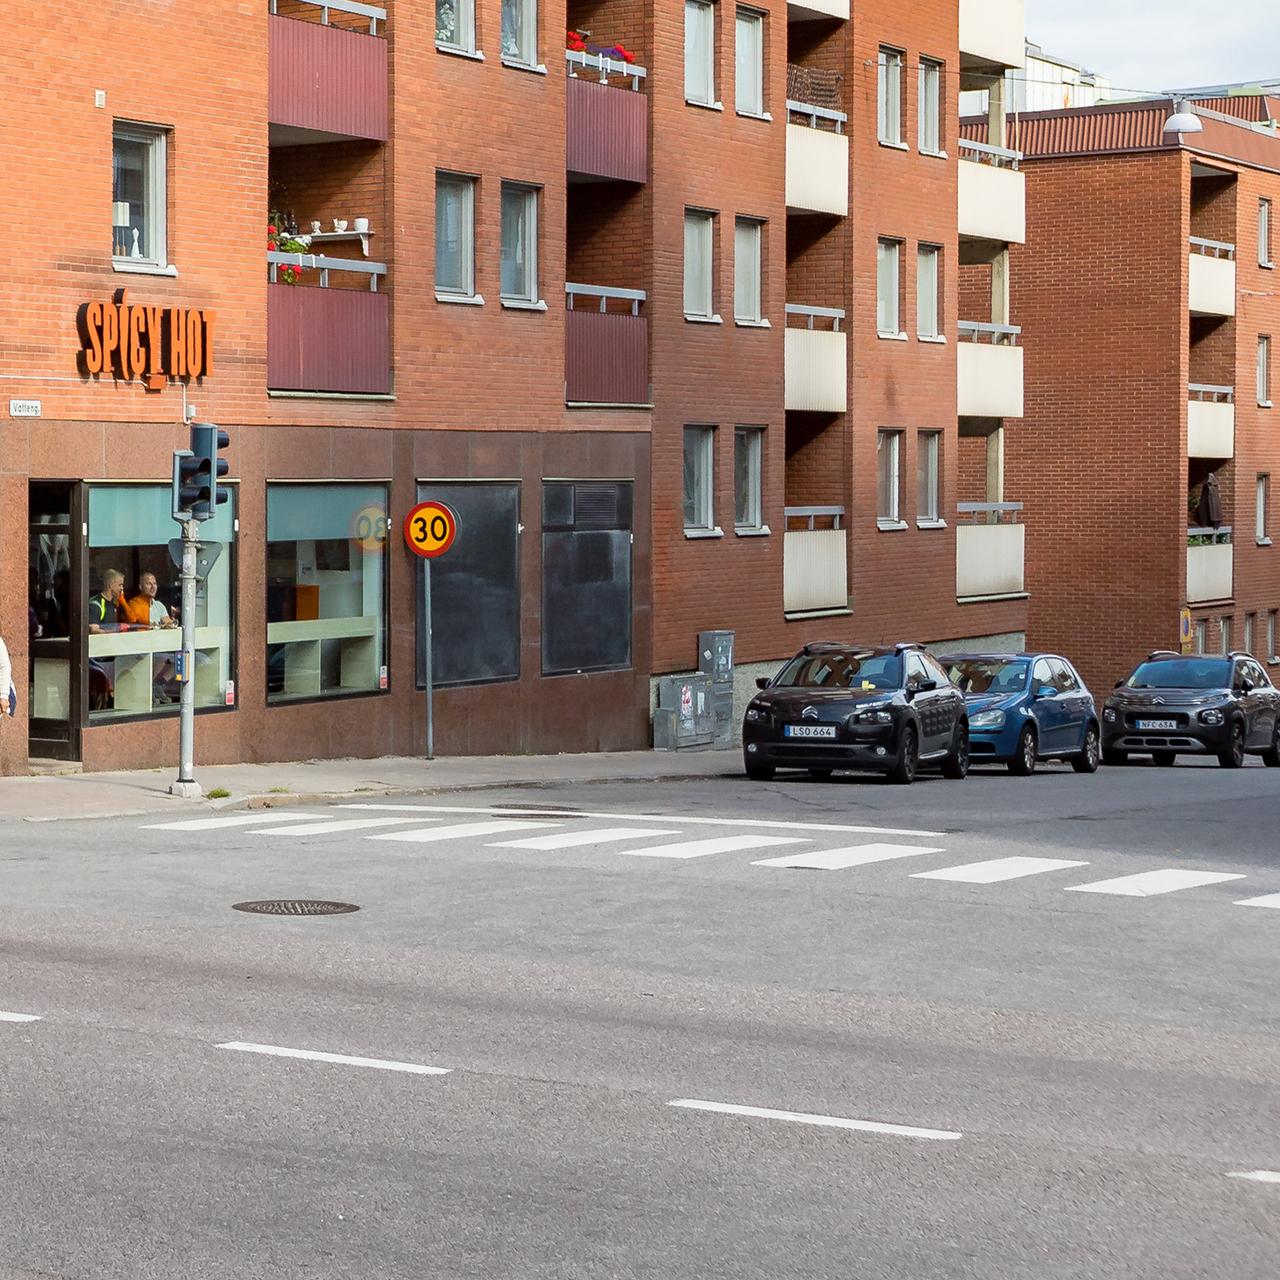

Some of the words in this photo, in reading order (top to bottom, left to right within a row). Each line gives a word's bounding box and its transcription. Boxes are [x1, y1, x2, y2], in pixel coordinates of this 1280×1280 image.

[84, 288, 164, 380] SPICY
[169, 308, 217, 377] HOT
[413, 515, 448, 543] 30
[792, 727, 811, 736] LSO
[812, 727, 831, 736] 664
